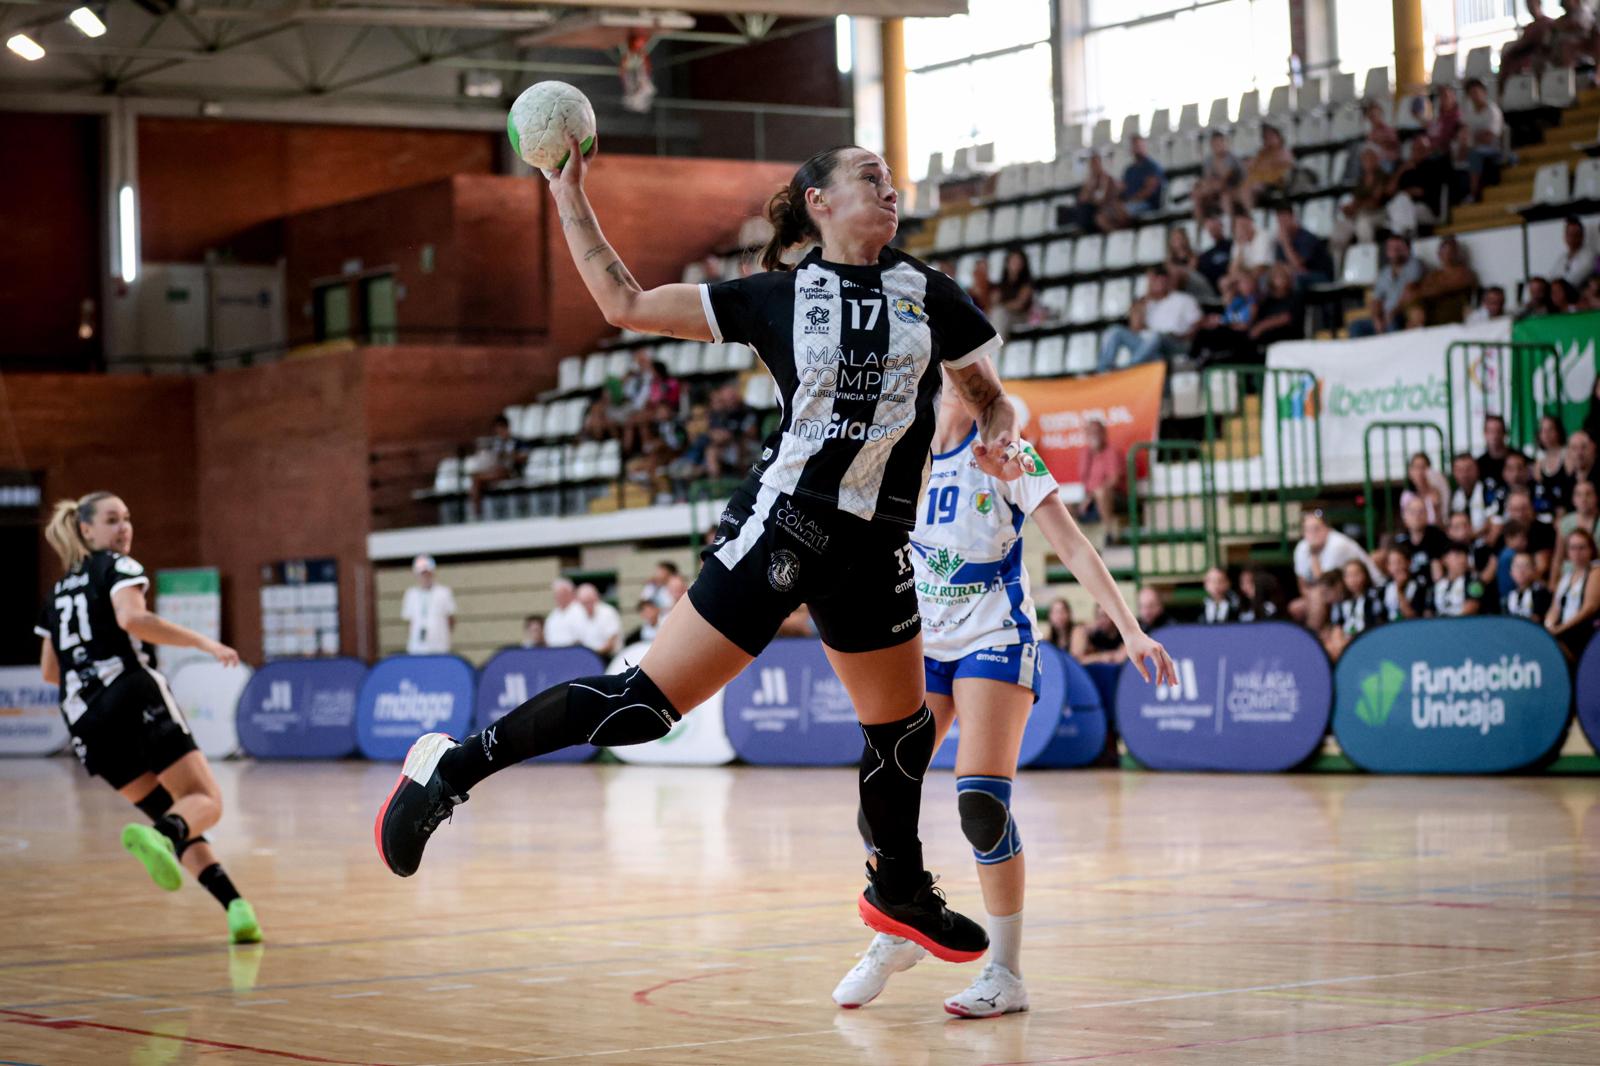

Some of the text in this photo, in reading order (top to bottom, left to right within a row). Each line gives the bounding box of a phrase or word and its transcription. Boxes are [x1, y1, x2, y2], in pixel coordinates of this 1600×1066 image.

[805, 292, 834, 301] Unicaja
[845, 299, 882, 331] 17
[806, 345, 914, 372] MÁLAGA
[801, 367, 919, 394] COMPITE
[818, 389, 864, 401] PROVINCIA
[926, 485, 960, 526] 19
[893, 542, 913, 576] 17
[940, 583, 987, 598] RURAL
[55, 592, 93, 651] 21
[1410, 654, 1542, 695] Fundación
[1410, 694, 1506, 736] Unicaja
